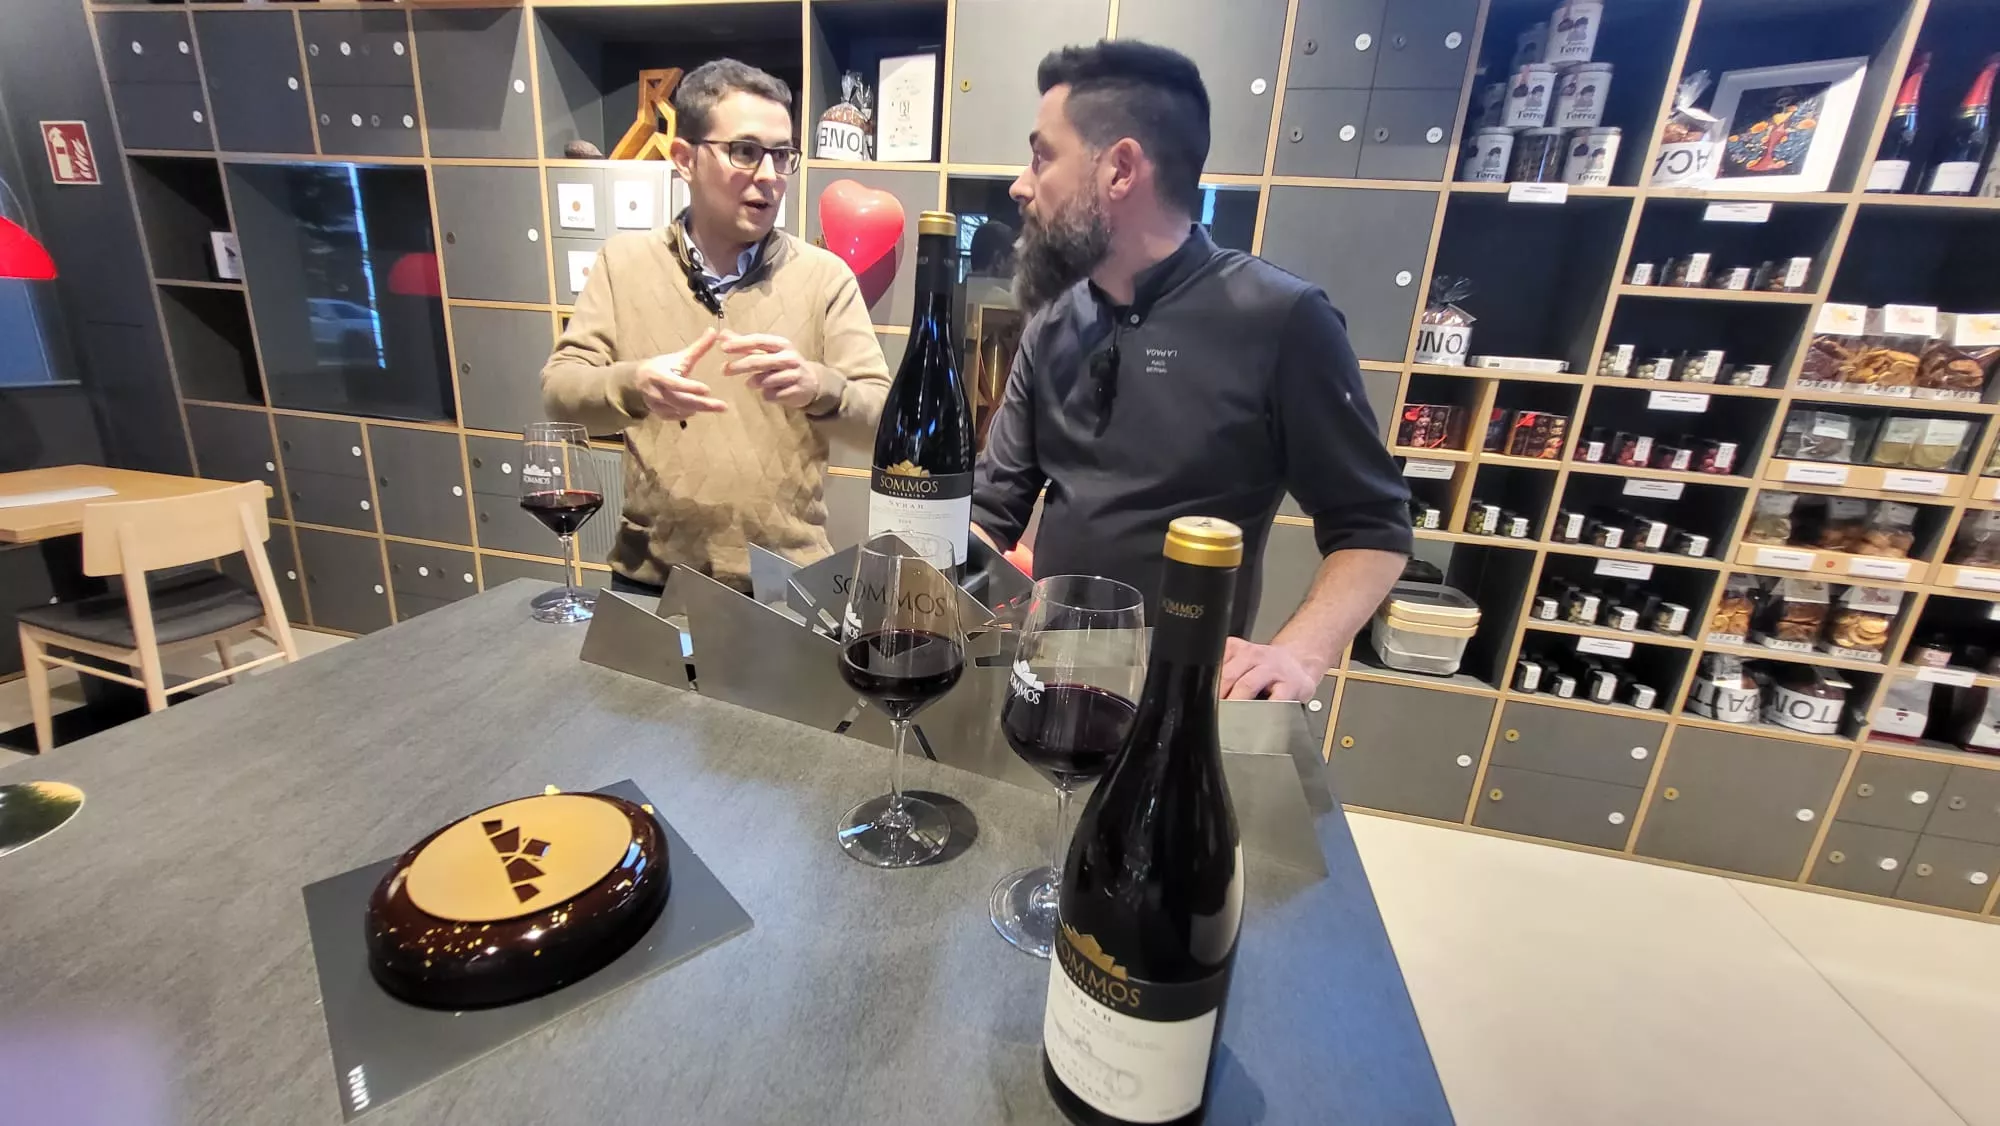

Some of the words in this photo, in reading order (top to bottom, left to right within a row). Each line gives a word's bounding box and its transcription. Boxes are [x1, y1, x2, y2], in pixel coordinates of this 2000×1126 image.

[820, 127, 862, 154] ONE
[879, 474, 939, 493] SOMMOS
[832, 574, 947, 617] SOMMOS
[1058, 941, 1142, 1008] OMMOS
